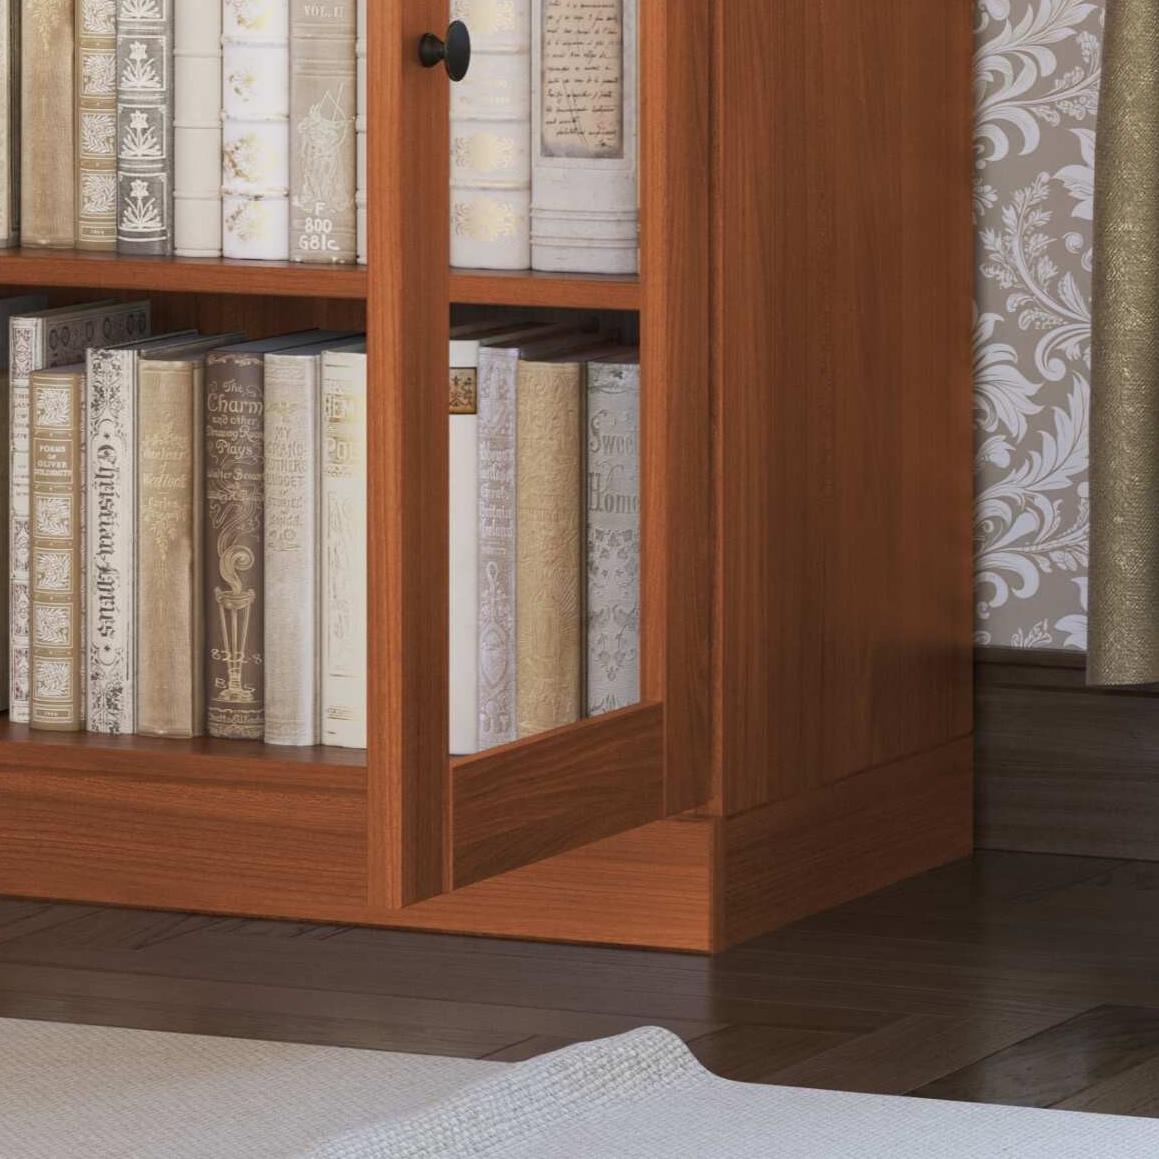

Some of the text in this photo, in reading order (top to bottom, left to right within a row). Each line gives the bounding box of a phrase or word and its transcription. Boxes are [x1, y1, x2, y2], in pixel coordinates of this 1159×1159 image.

[315, 201, 327, 216] F
[304, 217, 333, 234] 800
[223, 378, 244, 393] The
[206, 392, 264, 415] Charm
[216, 440, 255, 460] Plays
